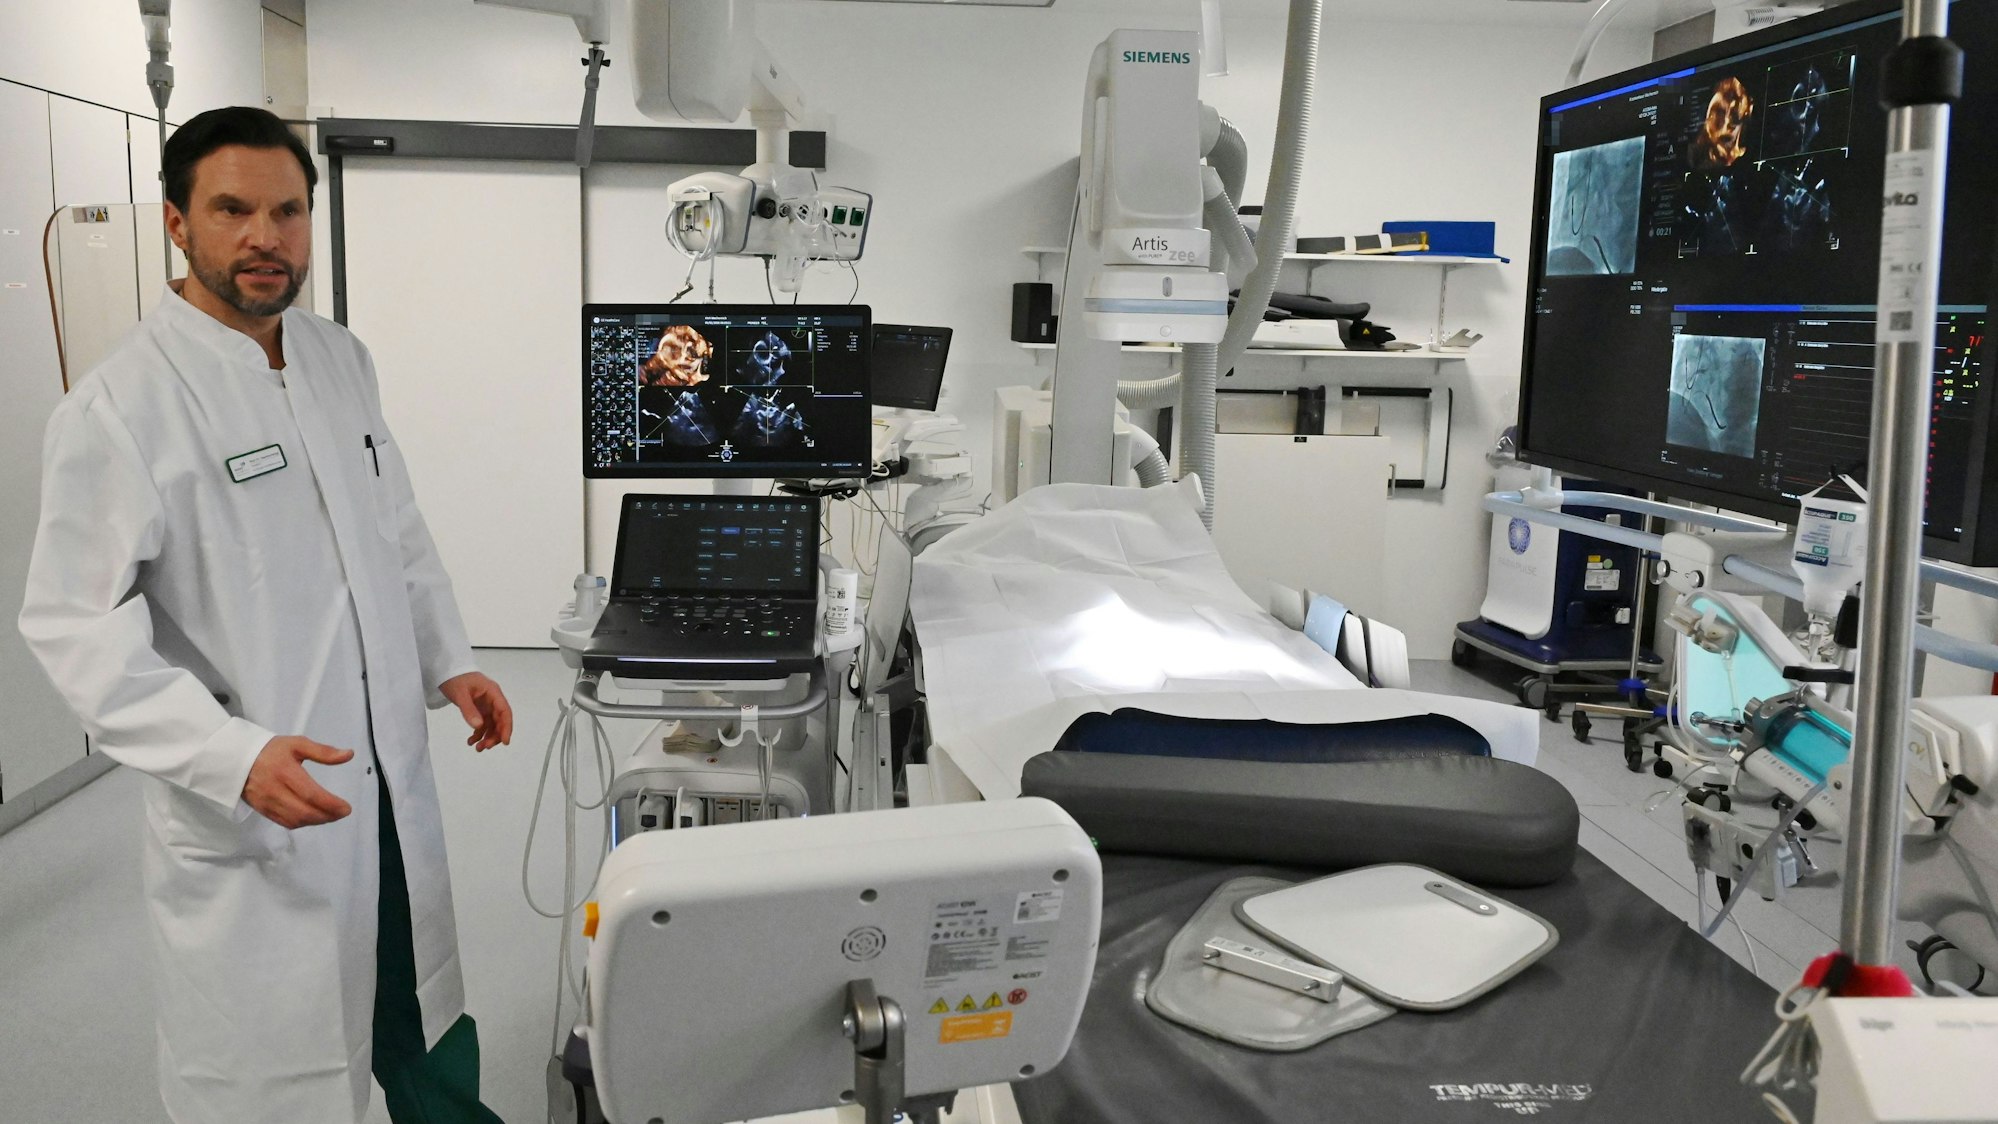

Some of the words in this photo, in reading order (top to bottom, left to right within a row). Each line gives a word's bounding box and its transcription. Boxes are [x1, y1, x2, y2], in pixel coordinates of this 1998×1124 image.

[1122, 50, 1191, 64] SIEMENS
[1131, 235, 1168, 251] Artis
[1168, 250, 1196, 263] zee
[1841, 513, 1854, 521] 350
[1428, 1082, 1593, 1097] TEMPUR-MED
